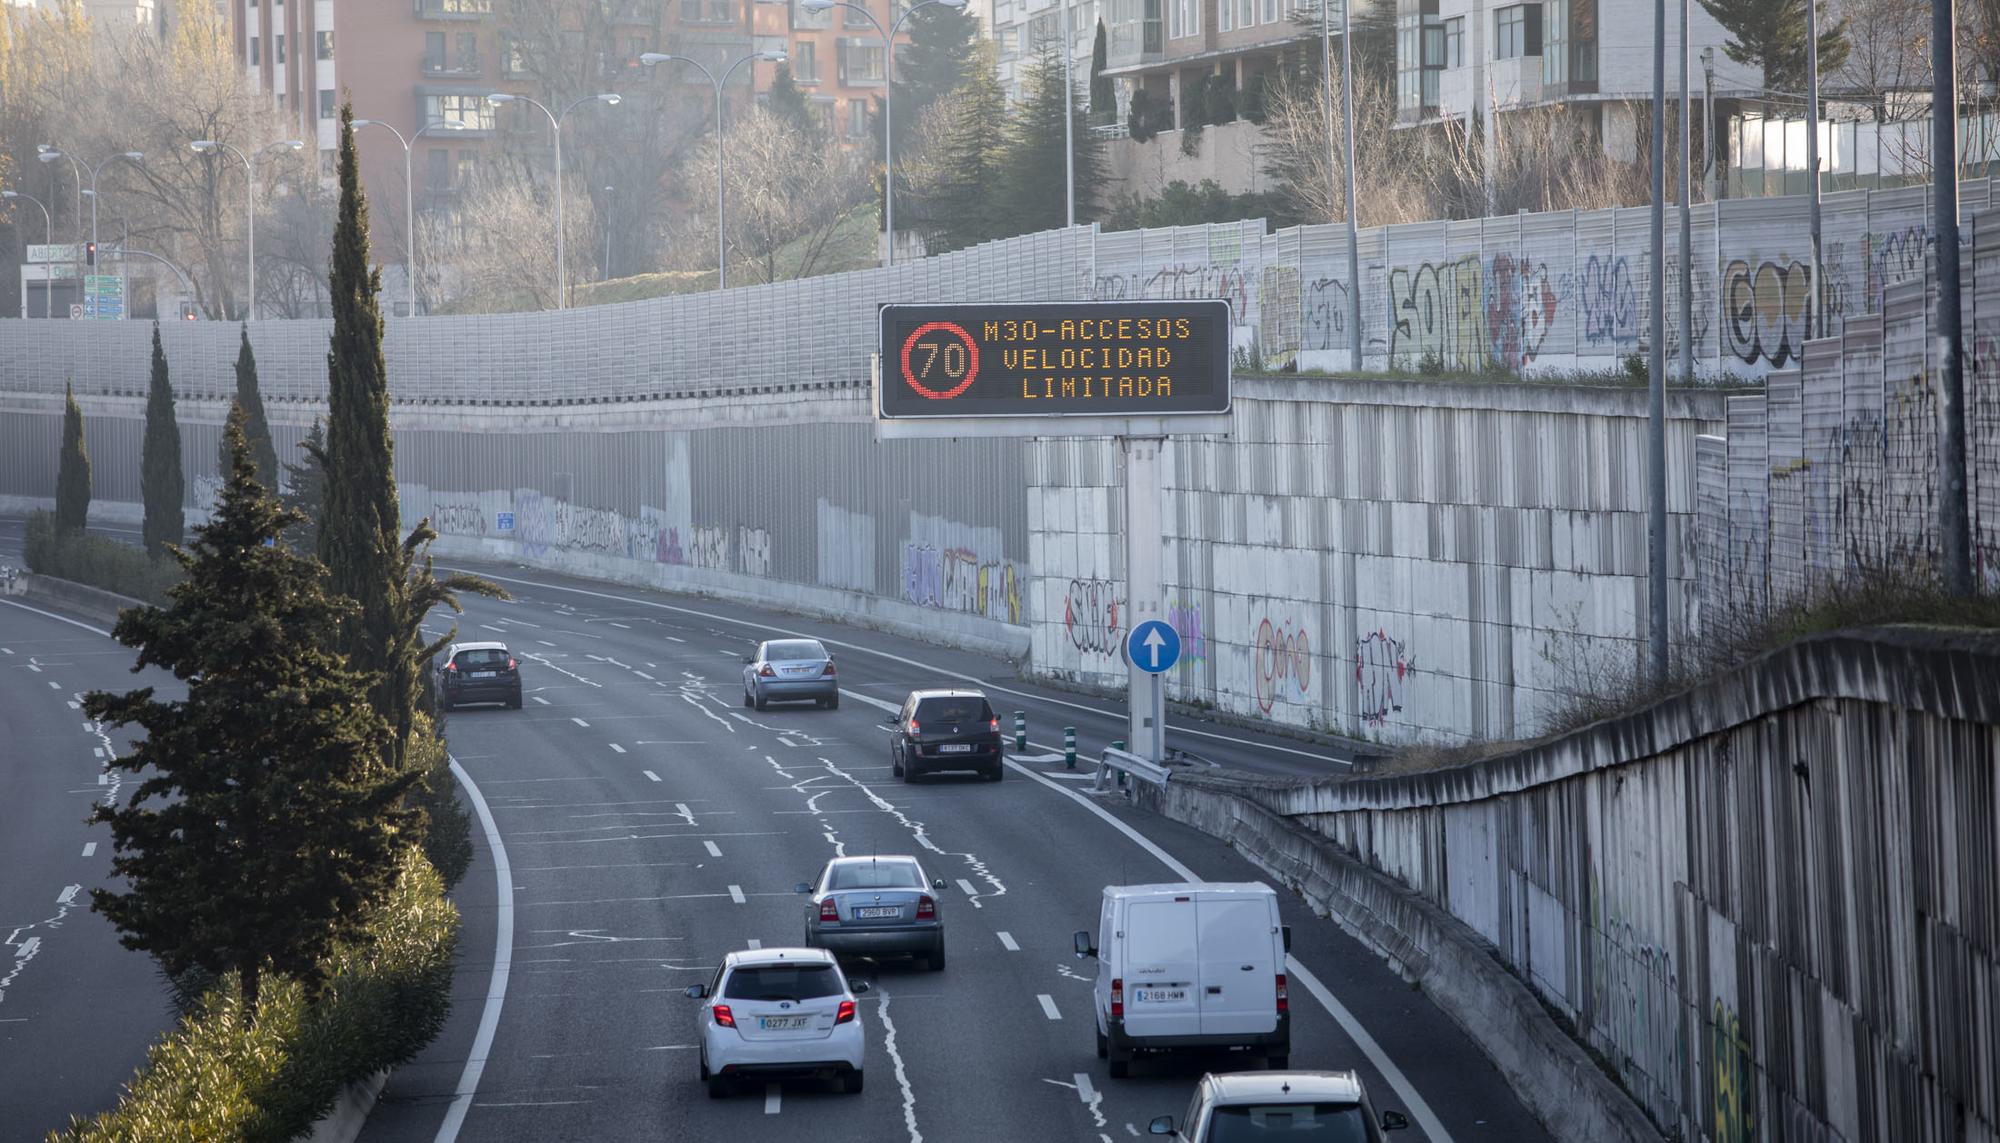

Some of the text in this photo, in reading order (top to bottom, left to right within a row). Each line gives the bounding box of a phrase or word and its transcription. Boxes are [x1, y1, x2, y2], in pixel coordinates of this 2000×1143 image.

[984, 318, 1191, 341] M30-ACCESOS
[918, 343, 965, 378] 70
[1004, 347, 1171, 370] VELOCIDAD
[1023, 376, 1172, 398] LIMITADA
[1143, 991, 1166, 1000] 2168
[766, 1017, 808, 1028] 0277 JXF
